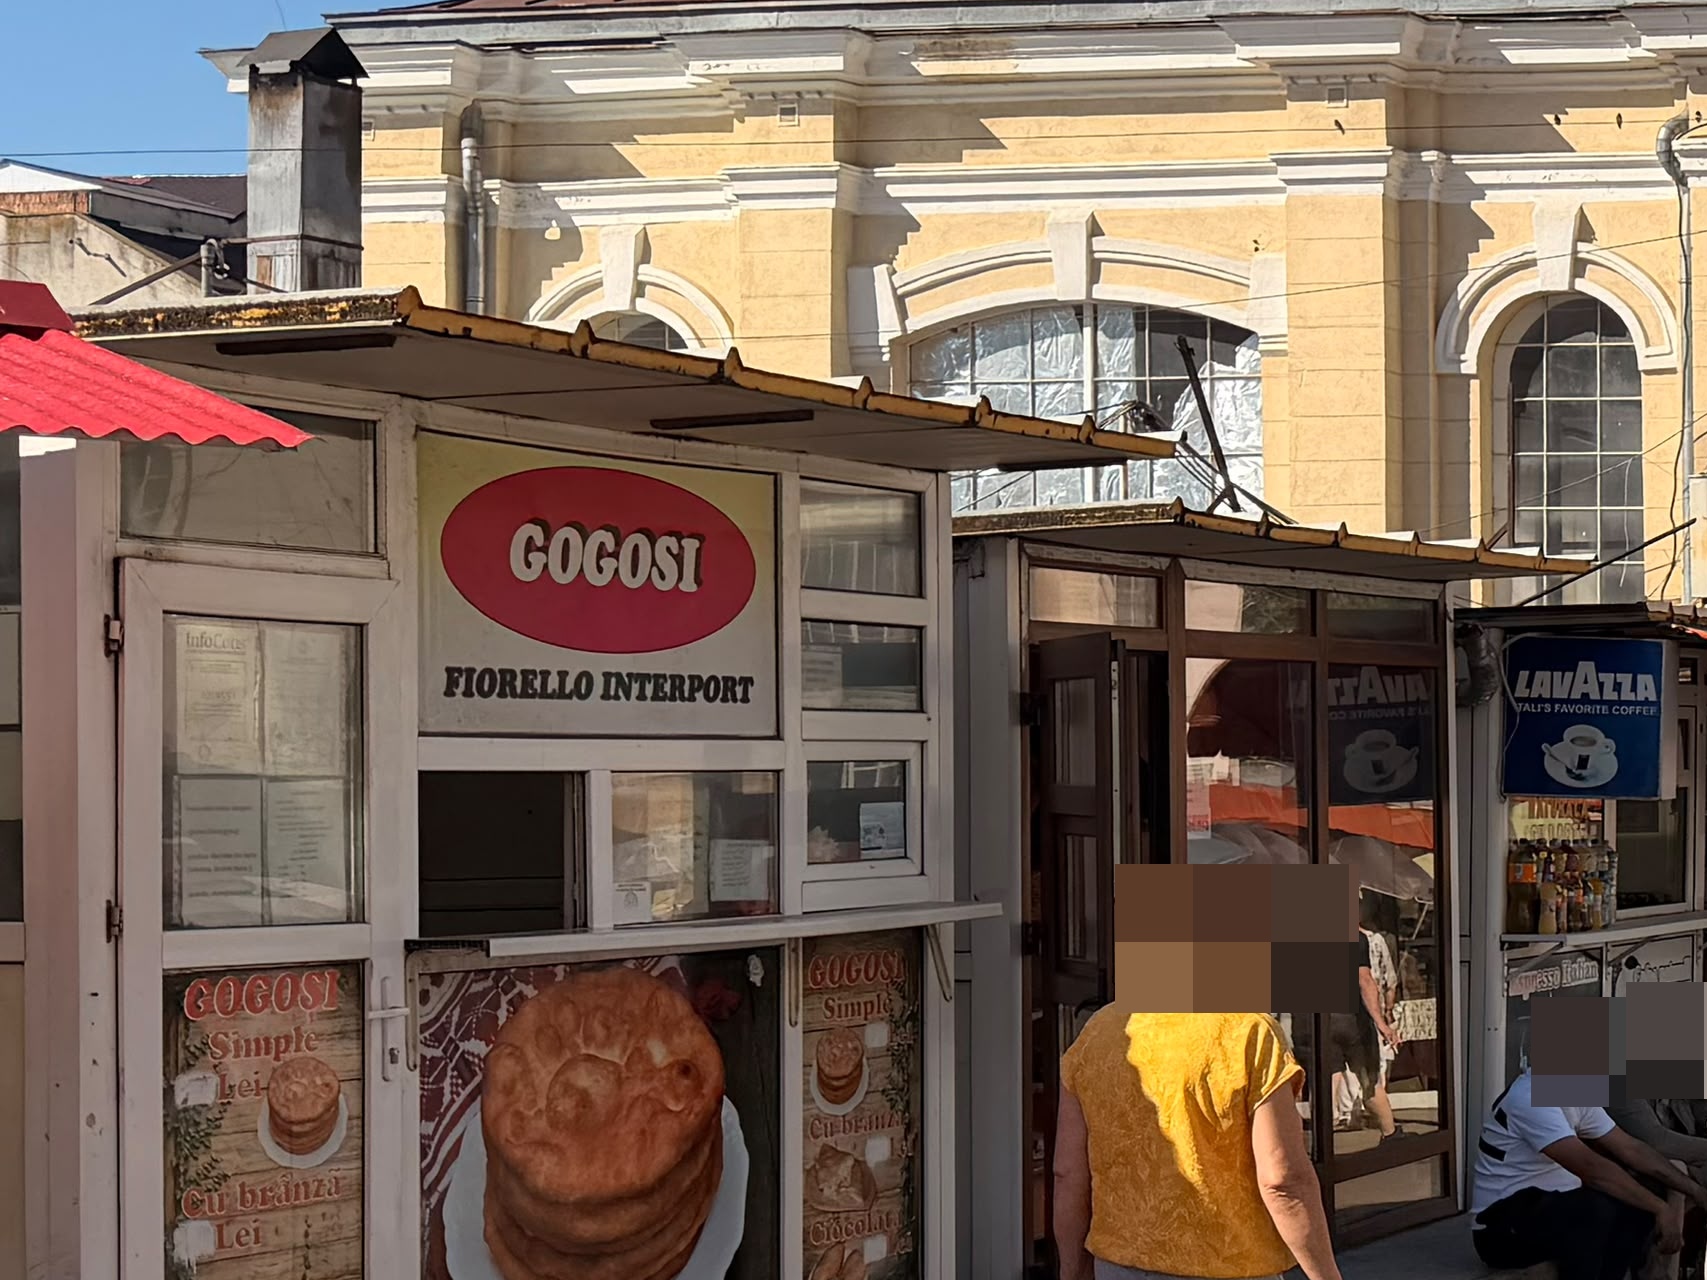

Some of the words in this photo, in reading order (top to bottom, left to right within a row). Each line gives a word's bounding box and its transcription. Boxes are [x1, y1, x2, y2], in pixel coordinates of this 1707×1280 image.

[510, 521, 703, 593] GOGOSI
[443, 666, 595, 701] FIORELLO
[599, 670, 755, 705] INTERPORT
[1513, 660, 1658, 702] LAVAZZA
[1554, 703, 1609, 715] FAVORITE
[1611, 704, 1658, 716] COFFEE
[808, 949, 905, 990] GOGOSI
[184, 969, 341, 1021] GOGOSI
[208, 1025, 319, 1062] Simple
[218, 1071, 263, 1103] Lei
[182, 1187, 229, 1219] Cu
[215, 1219, 263, 1251] Lei
